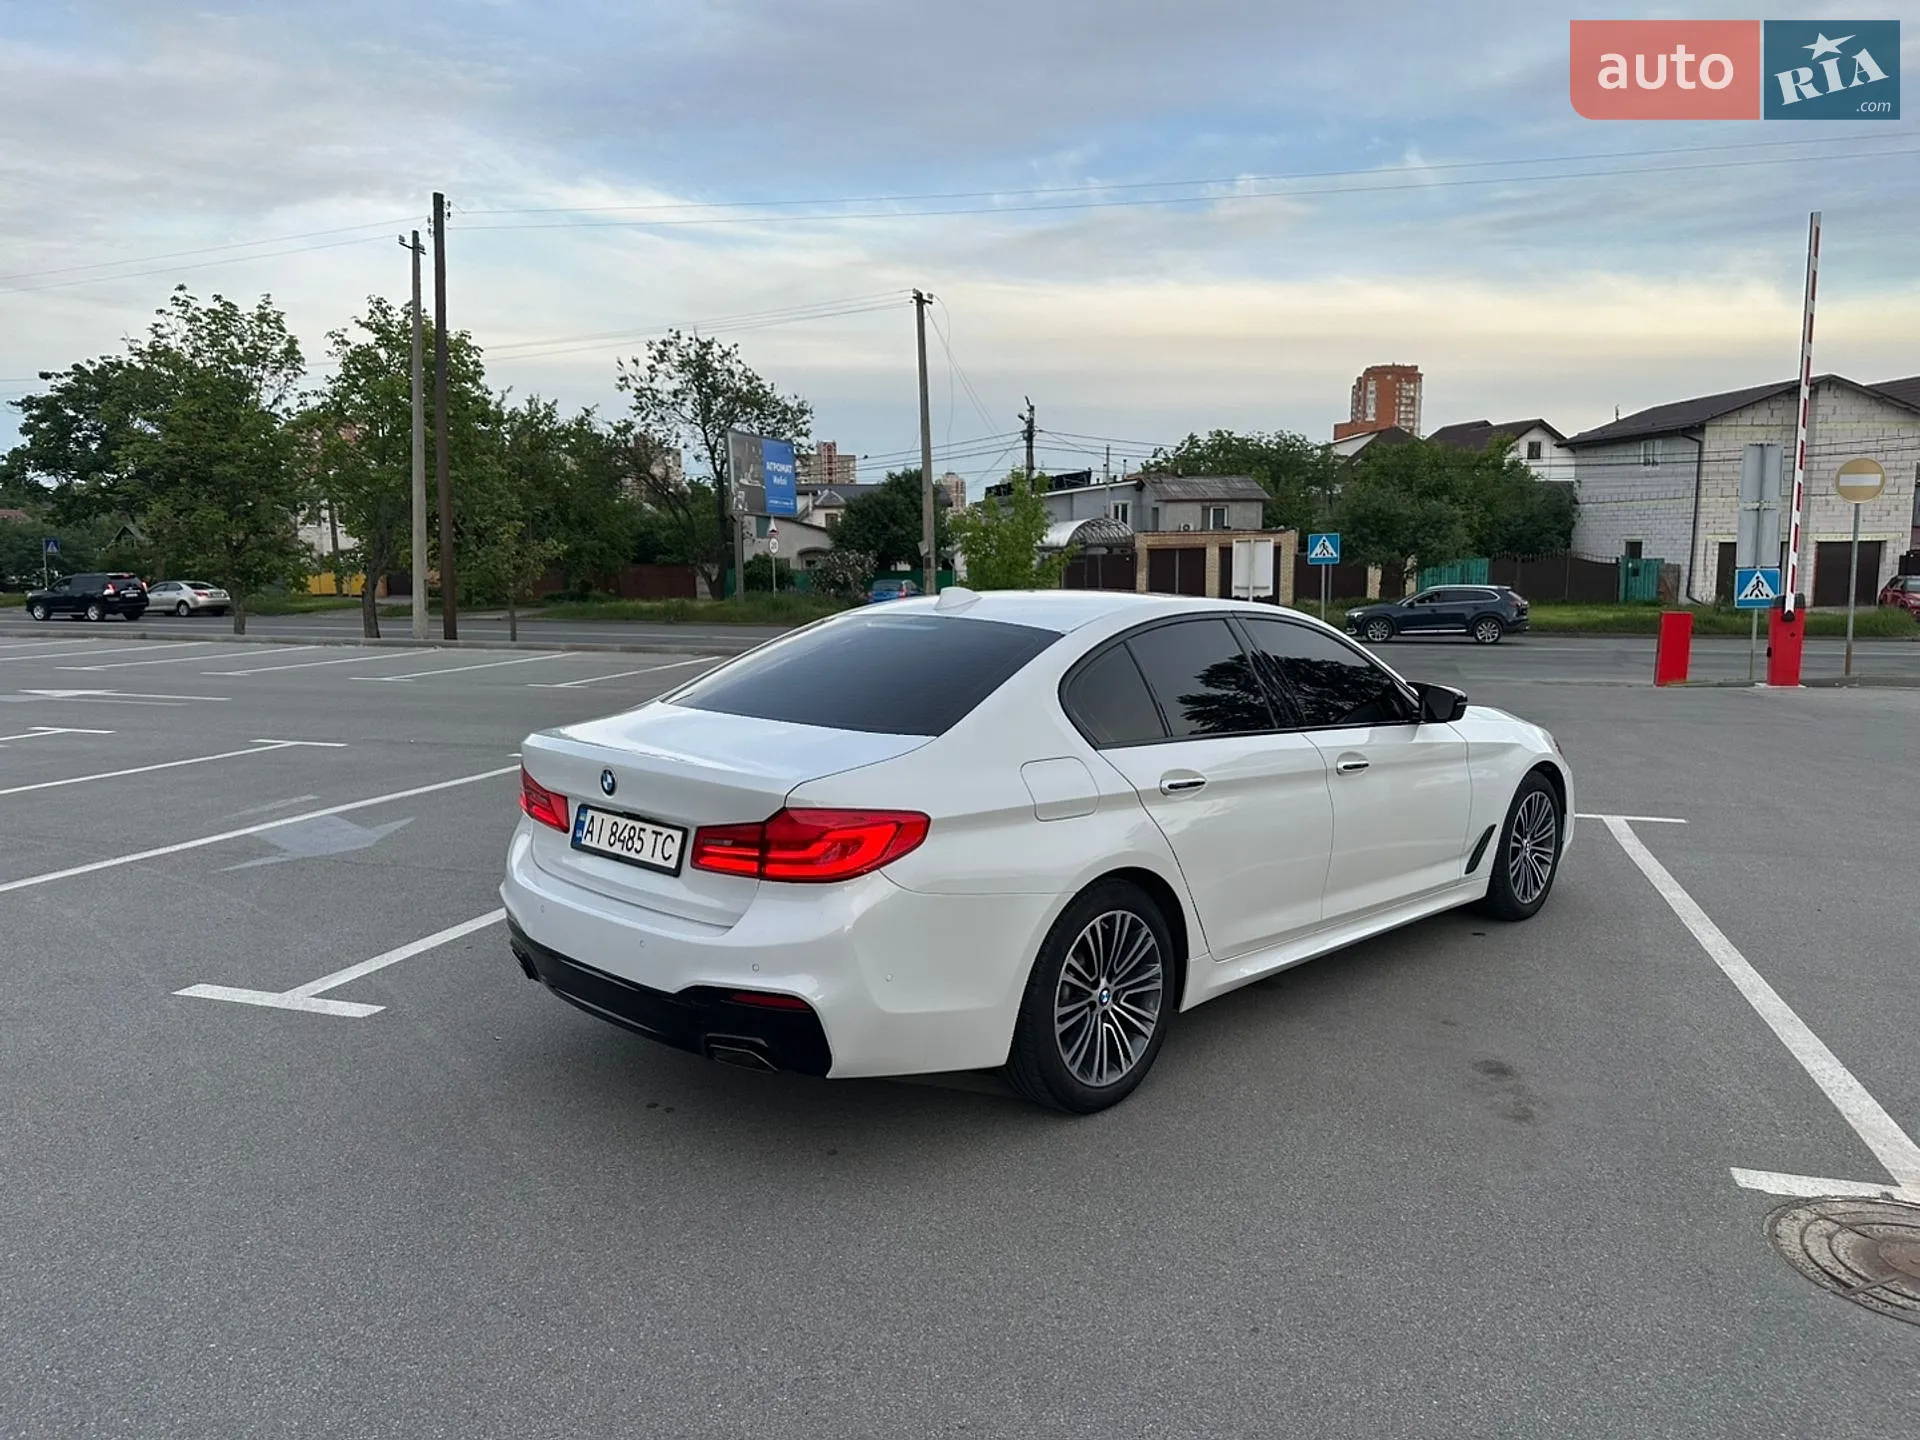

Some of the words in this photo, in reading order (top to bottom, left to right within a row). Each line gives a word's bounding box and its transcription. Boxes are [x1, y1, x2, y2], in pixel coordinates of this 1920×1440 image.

[584, 815, 605, 844] AI
[608, 821, 646, 854] 8485
[651, 830, 675, 861] TC
